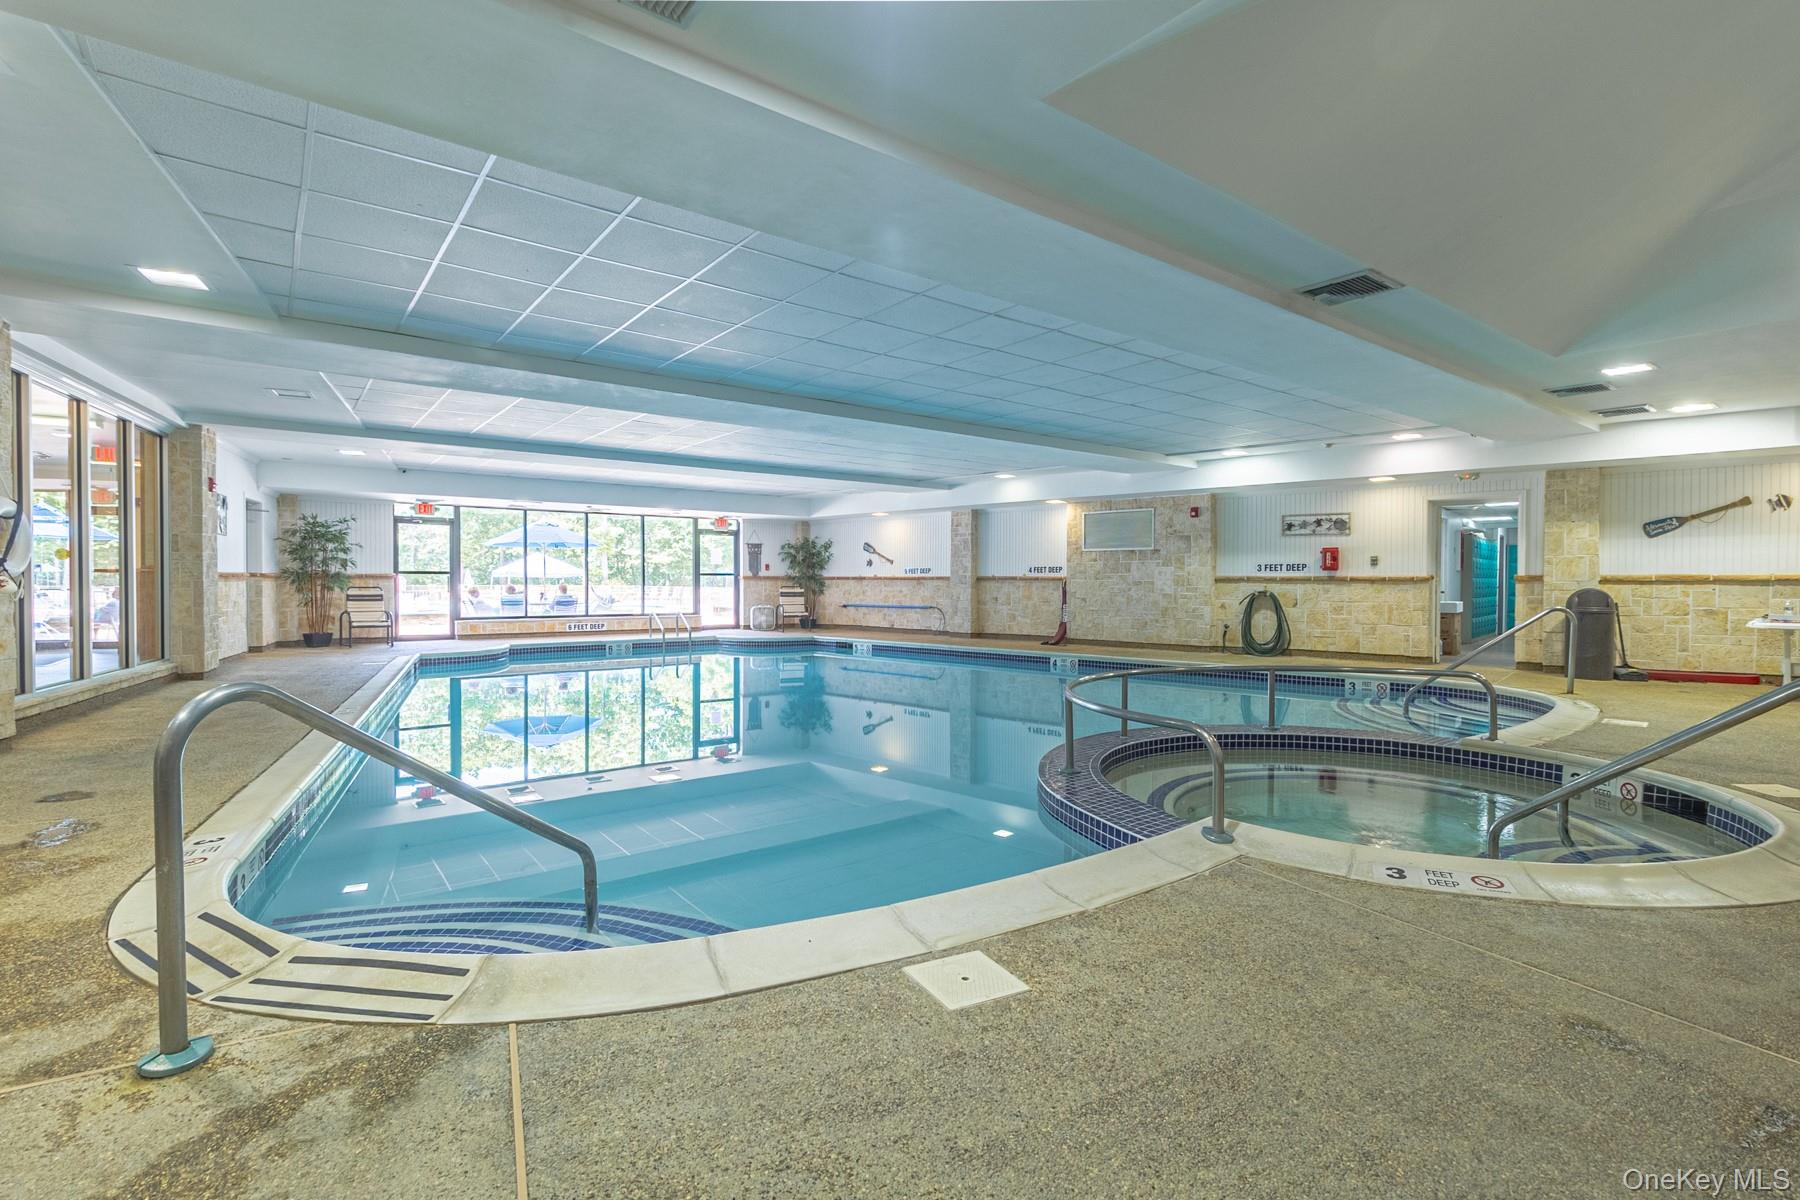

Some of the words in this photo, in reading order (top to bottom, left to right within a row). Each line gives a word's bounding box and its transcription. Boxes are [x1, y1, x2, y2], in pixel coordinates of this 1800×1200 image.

[920, 567, 931, 575] DEEP
[1256, 564, 1262, 572] 3
[1264, 564, 1284, 572] FEET
[1286, 563, 1307, 572] DEEP
[1385, 867, 1407, 880] 3
[1425, 869, 1454, 880] FEET
[1427, 878, 1460, 888] DEEP
